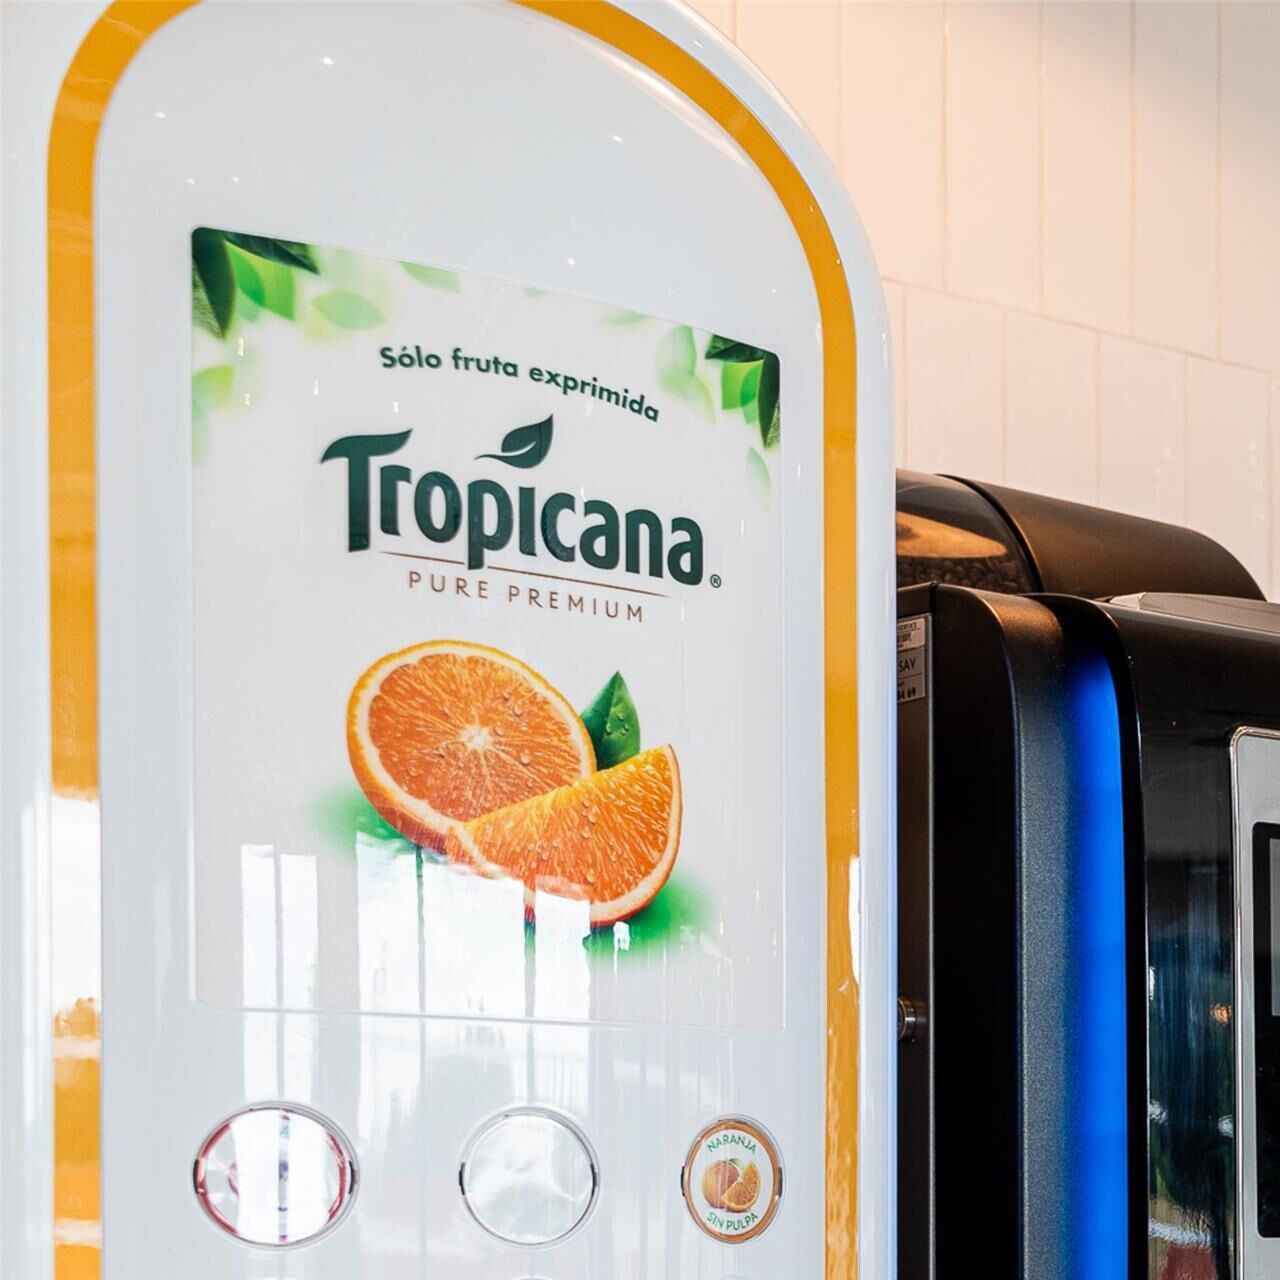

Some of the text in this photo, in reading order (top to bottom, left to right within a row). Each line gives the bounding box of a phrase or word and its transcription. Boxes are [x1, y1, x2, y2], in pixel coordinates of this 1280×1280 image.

[379, 345, 660, 423] Sólo fruta exprimida
[320, 426, 705, 587] Tropicana
[408, 570, 645, 624] PURE PREMIUM
[706, 1134, 758, 1155] NARANJA
[706, 1211, 759, 1231] SIN PULPA
